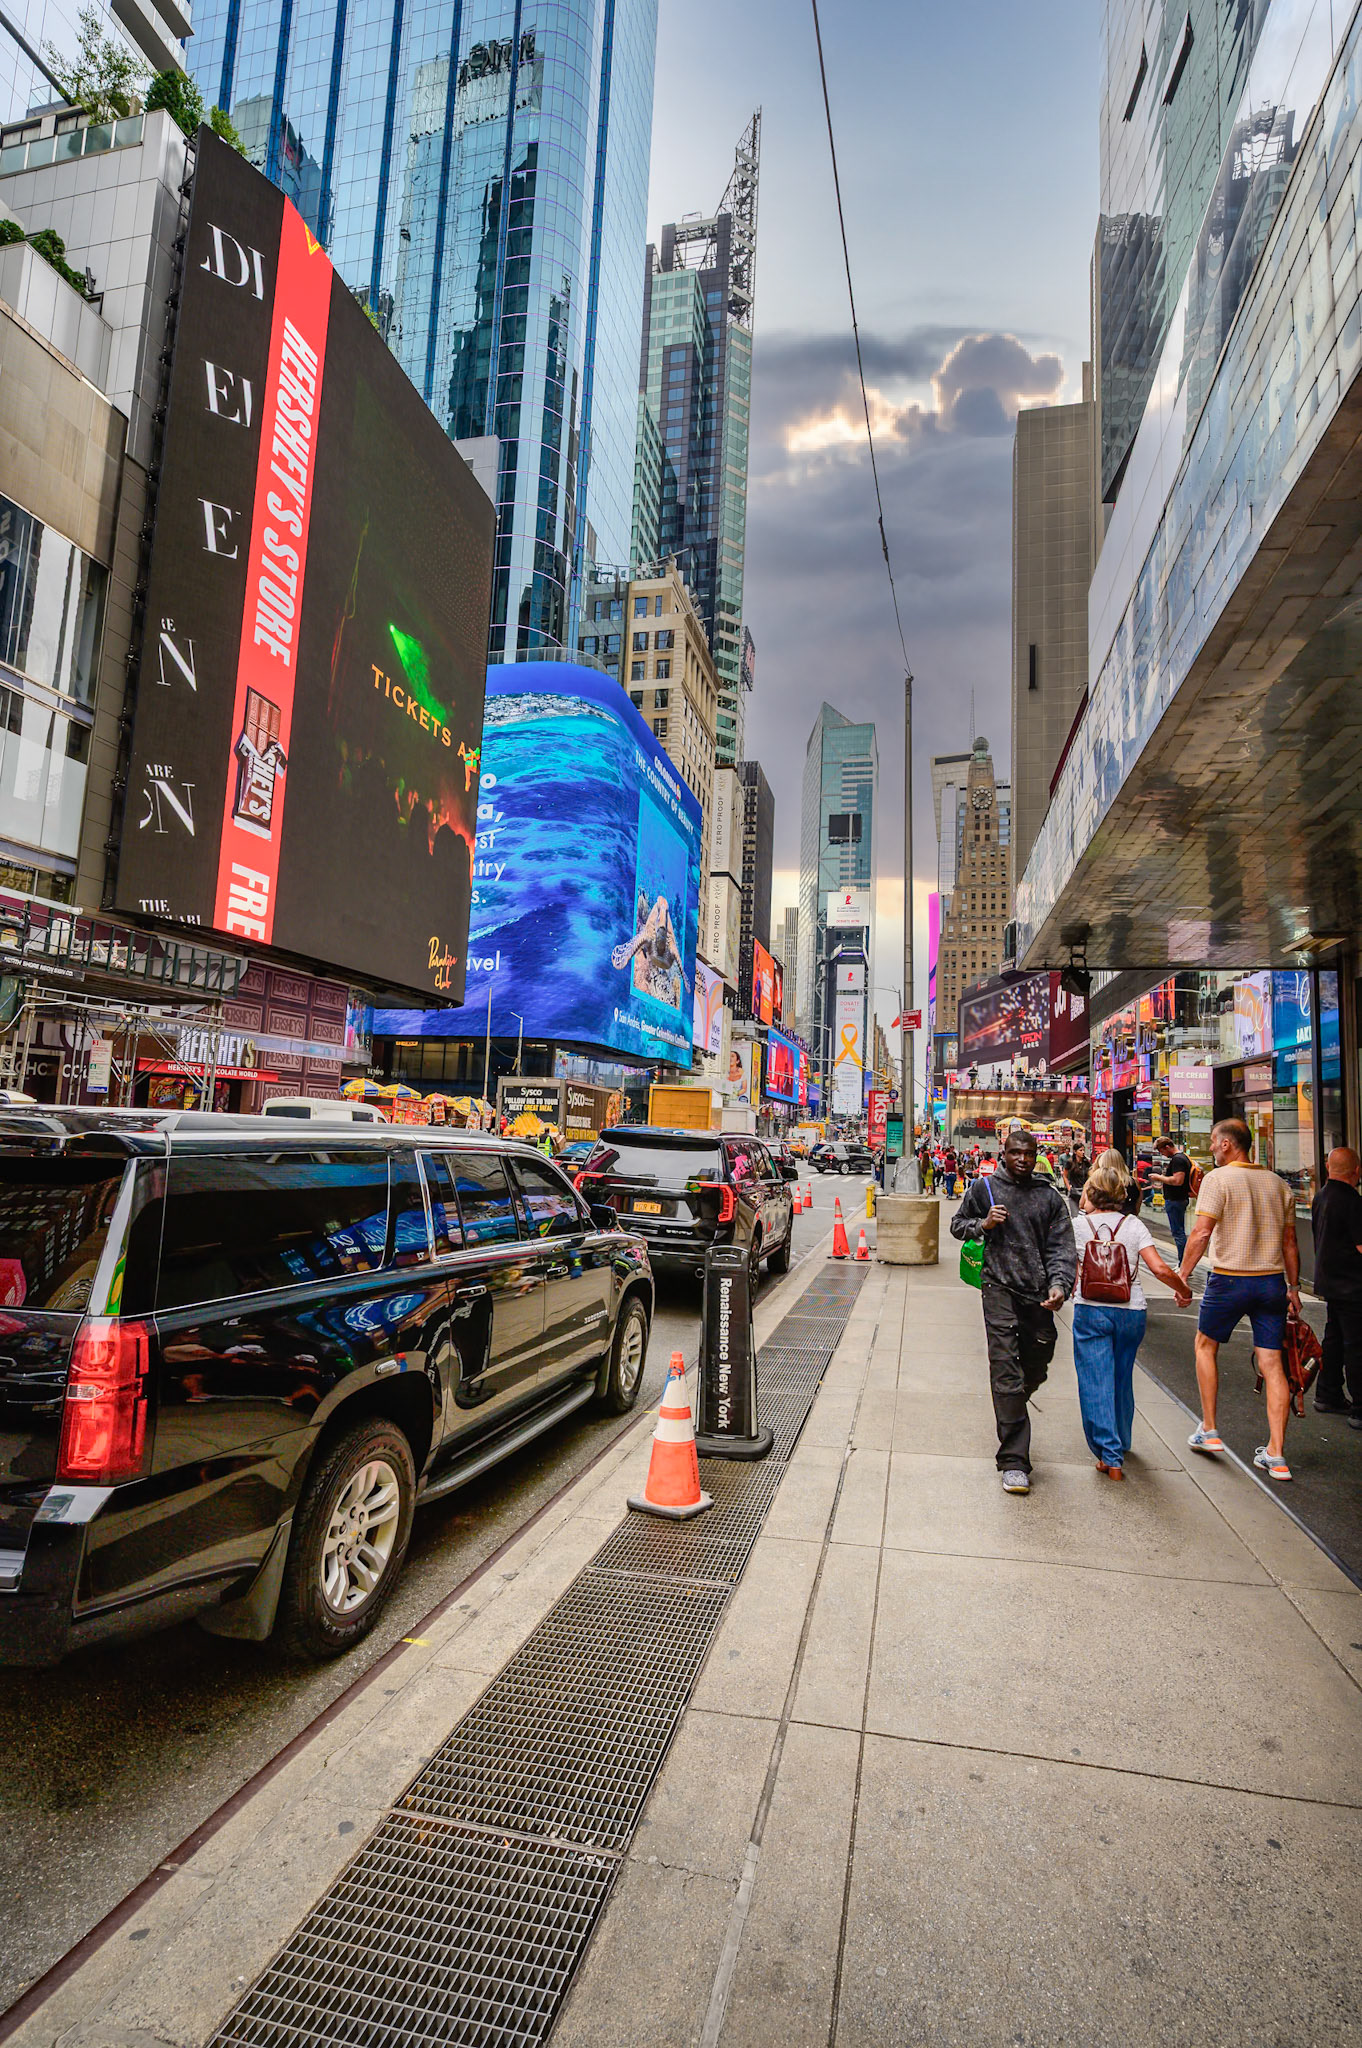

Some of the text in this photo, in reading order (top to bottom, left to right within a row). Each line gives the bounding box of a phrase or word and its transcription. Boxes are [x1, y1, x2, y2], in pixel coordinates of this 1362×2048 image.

[254, 316, 318, 667] HERSHEY'S STORE
[371, 663, 452, 748] TICKETS
[636, 749, 646, 773] THE
[139, 899, 170, 912] THE
[275, 975, 307, 999] HERSHEY'S
[317, 984, 344, 1006] HERSHEY'S
[223, 1004, 259, 1027] HERSHEY'S
[272, 1012, 304, 1036] HERSHEY'S
[313, 1019, 342, 1043] HERSHEY'S
[1020, 1030, 1042, 1044] TRON
[178, 1026, 256, 1068] HERSHEY'S
[239, 1070, 258, 1079] WORLD
[526, 1097, 535, 1105] ME
[544, 1098, 559, 1106] YOUR
[1172, 1092, 1212, 1100] MILKSHAKES
[874, 1094, 889, 1124] tkts
[717, 1277, 733, 1429] Renaissance New York
